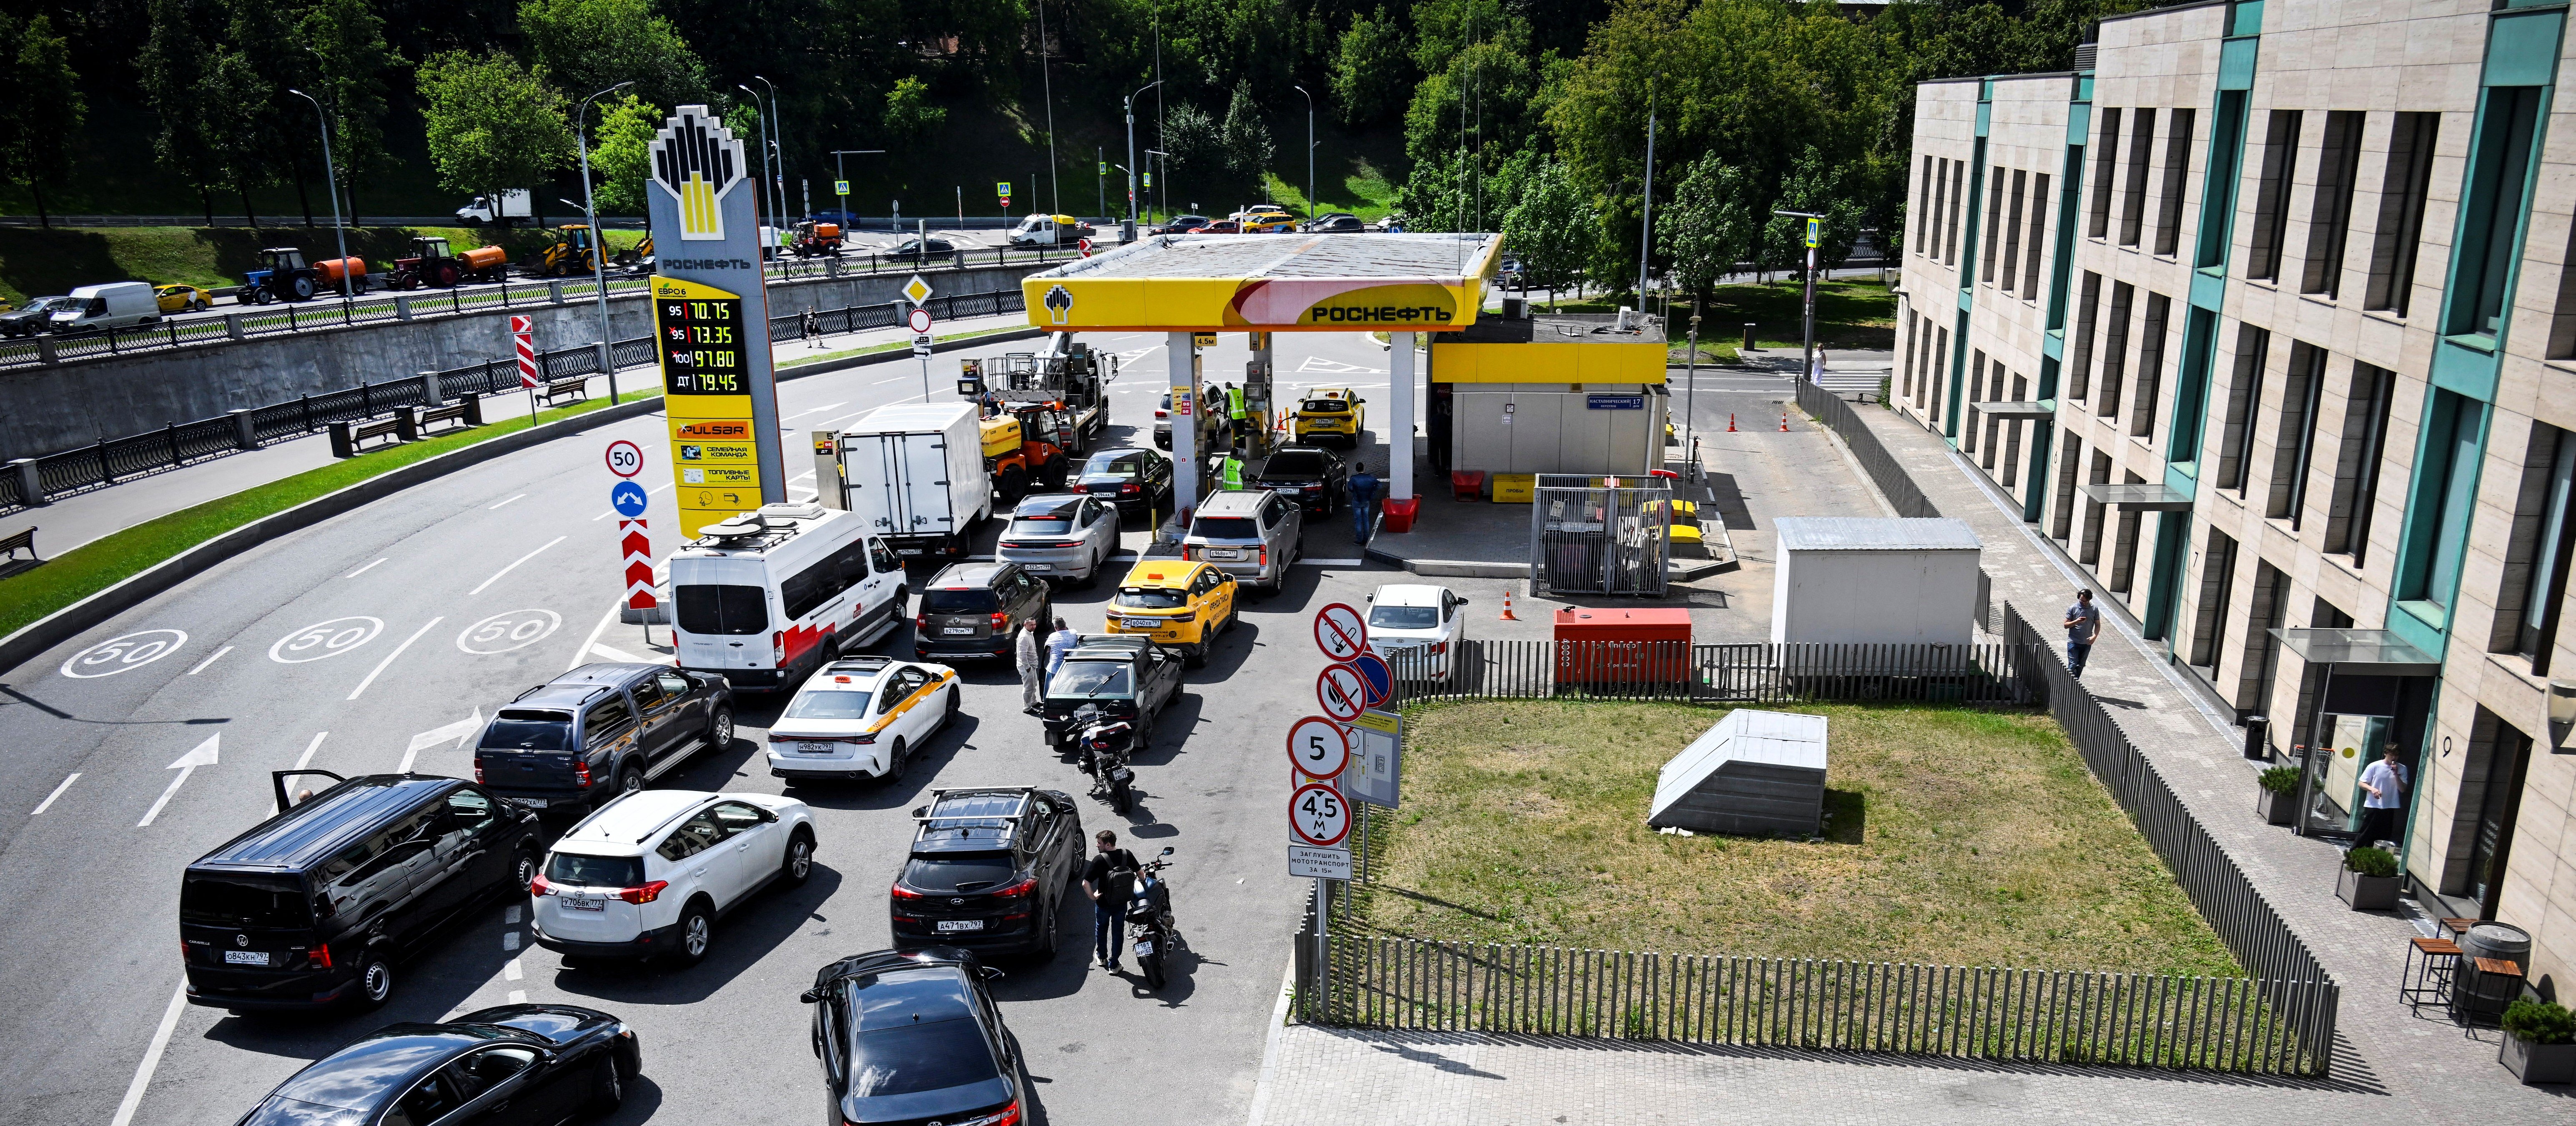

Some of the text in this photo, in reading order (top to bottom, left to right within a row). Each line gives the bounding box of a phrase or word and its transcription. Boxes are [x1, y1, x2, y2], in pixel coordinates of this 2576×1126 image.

[662, 259, 750, 269] РОСНЕФТЬ
[669, 303, 729, 319] 95 70.75
[1312, 307, 1451, 321] РОСНЕФТЬ
[672, 327, 732, 343] 95 73.35
[674, 351, 734, 367] 100 97.80
[677, 375, 737, 390] ДТ 79.45
[614, 452, 635, 466] 50
[2193, 551, 2199, 568] 7
[1209, 598, 1221, 612] АРЕНДА
[1220, 593, 1229, 603] ТАКСИ
[479, 618, 546, 642] 50
[289, 627, 365, 651] 50
[84, 641, 167, 665] 50
[1310, 736, 1325, 761] 5
[2443, 736, 2452, 758] 9
[1302, 796, 1337, 819] 4,5
[1314, 820, 1326, 831] М
[1292, 858, 1349, 868] МОТОТРАНСПОРТ
